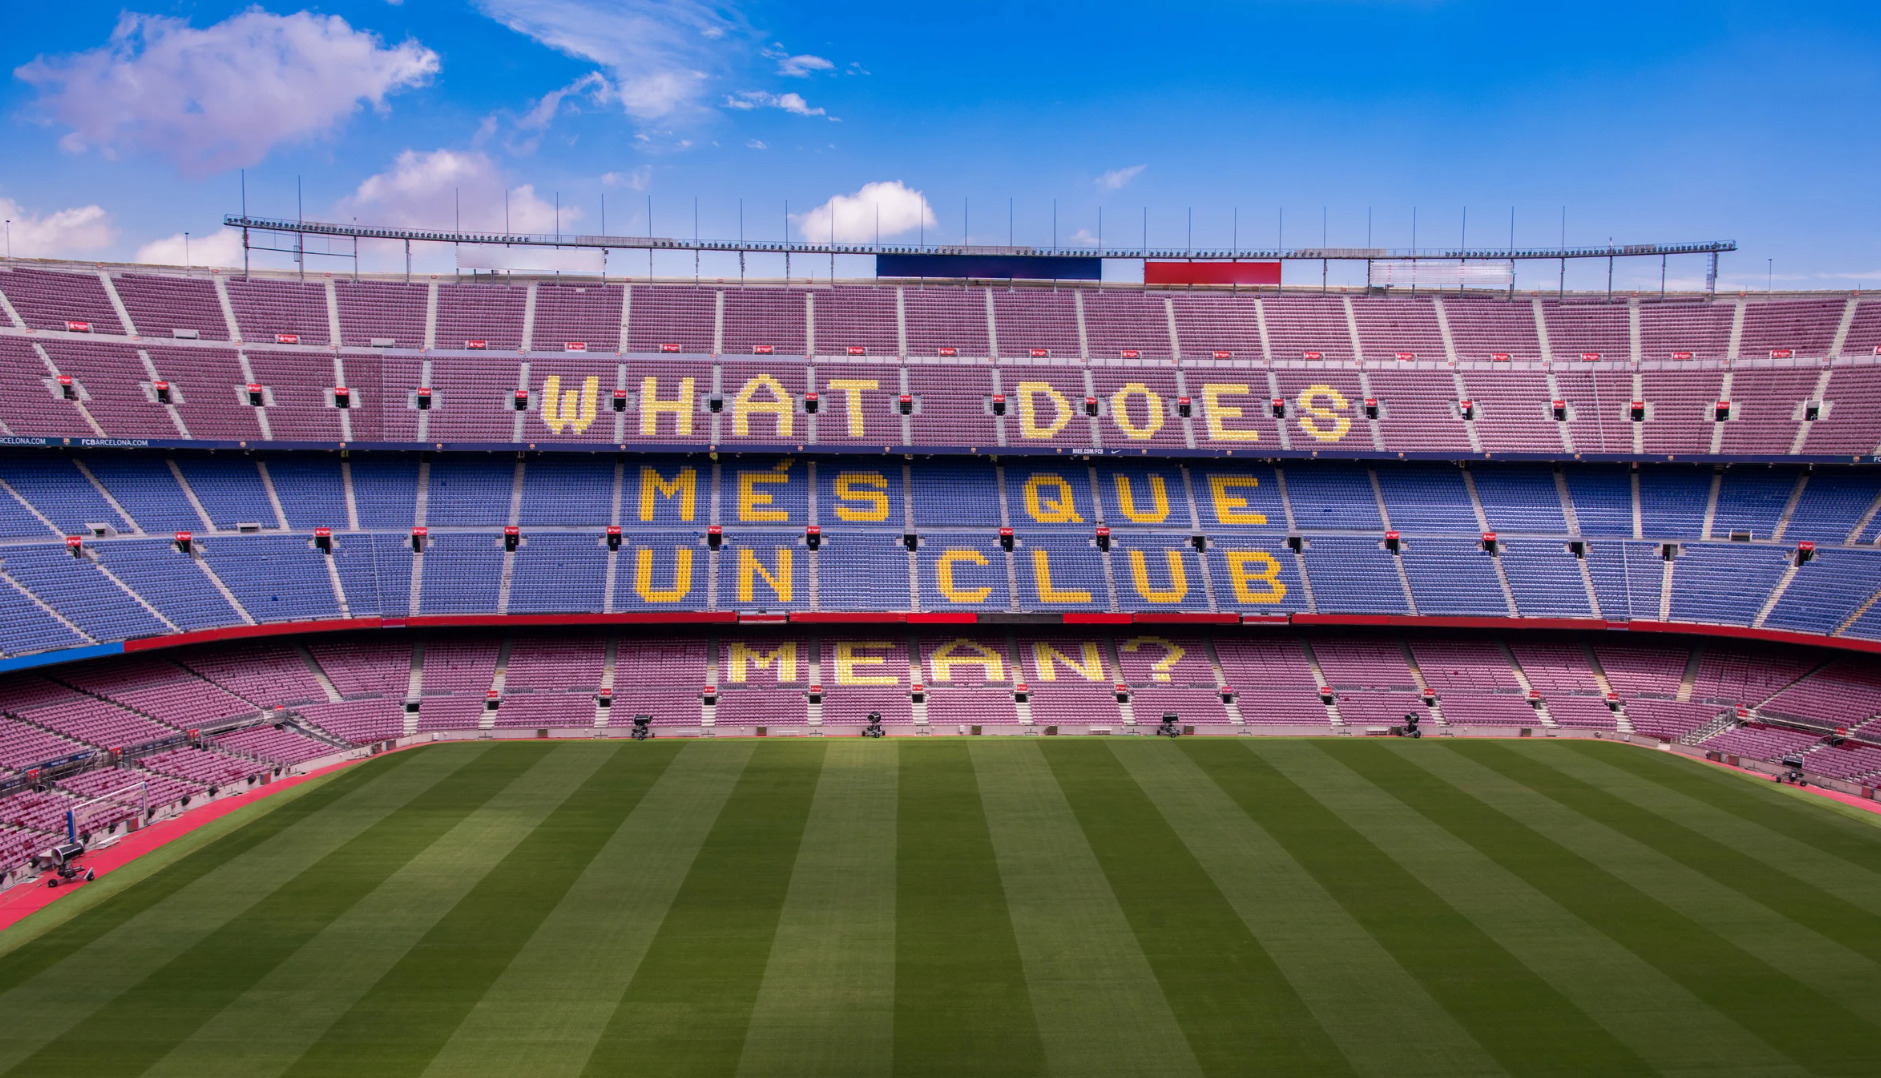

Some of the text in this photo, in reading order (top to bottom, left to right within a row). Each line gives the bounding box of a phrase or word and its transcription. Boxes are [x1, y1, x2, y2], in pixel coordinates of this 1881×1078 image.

[540, 373, 1352, 442] WHAT DOES
[81, 438, 148, 447] FCBARCELONA.COM
[638, 458, 1269, 525] MÉS QUE
[635, 547, 1288, 605] UN CLUB
[730, 636, 1186, 686] MEAN?
